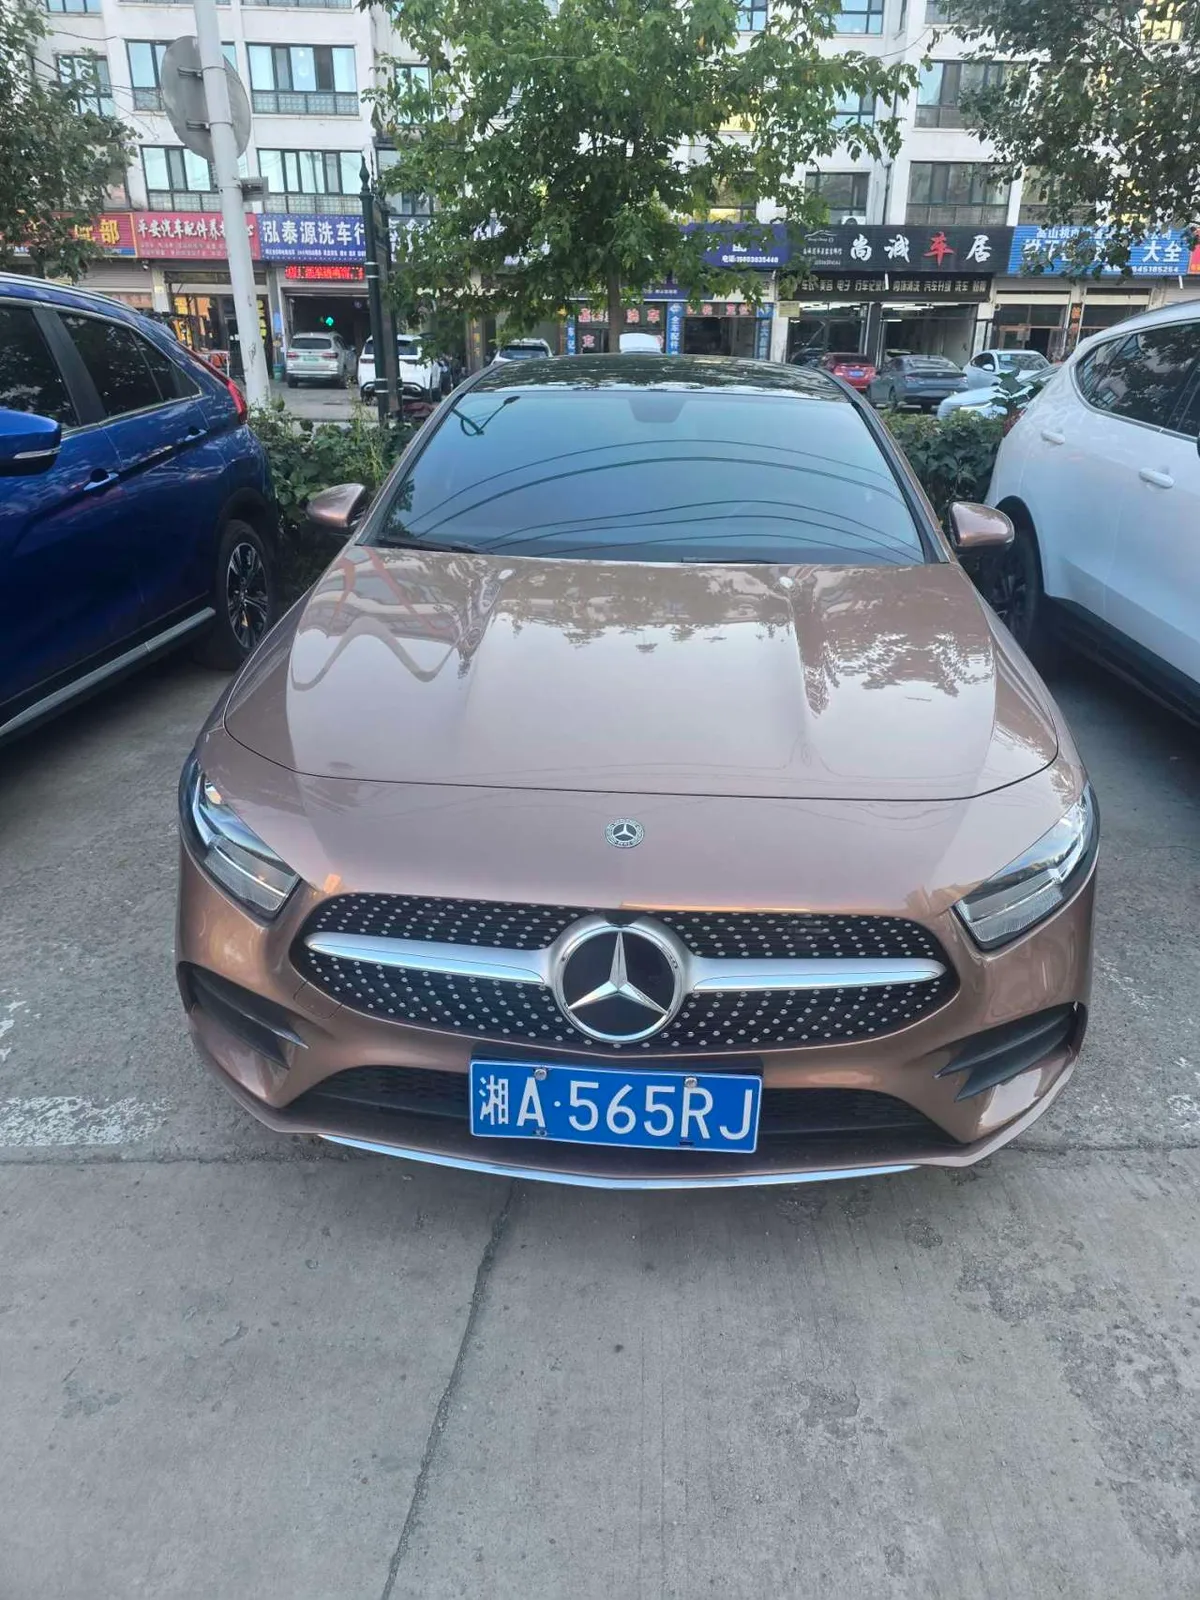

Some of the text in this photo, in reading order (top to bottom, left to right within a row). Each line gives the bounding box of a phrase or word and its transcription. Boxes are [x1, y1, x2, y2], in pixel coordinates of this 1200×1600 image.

[837, 279, 850, 291] 电子
[955, 280, 969, 292] 洗车
[479, 1074, 754, 1141] 湘A·565RJ
